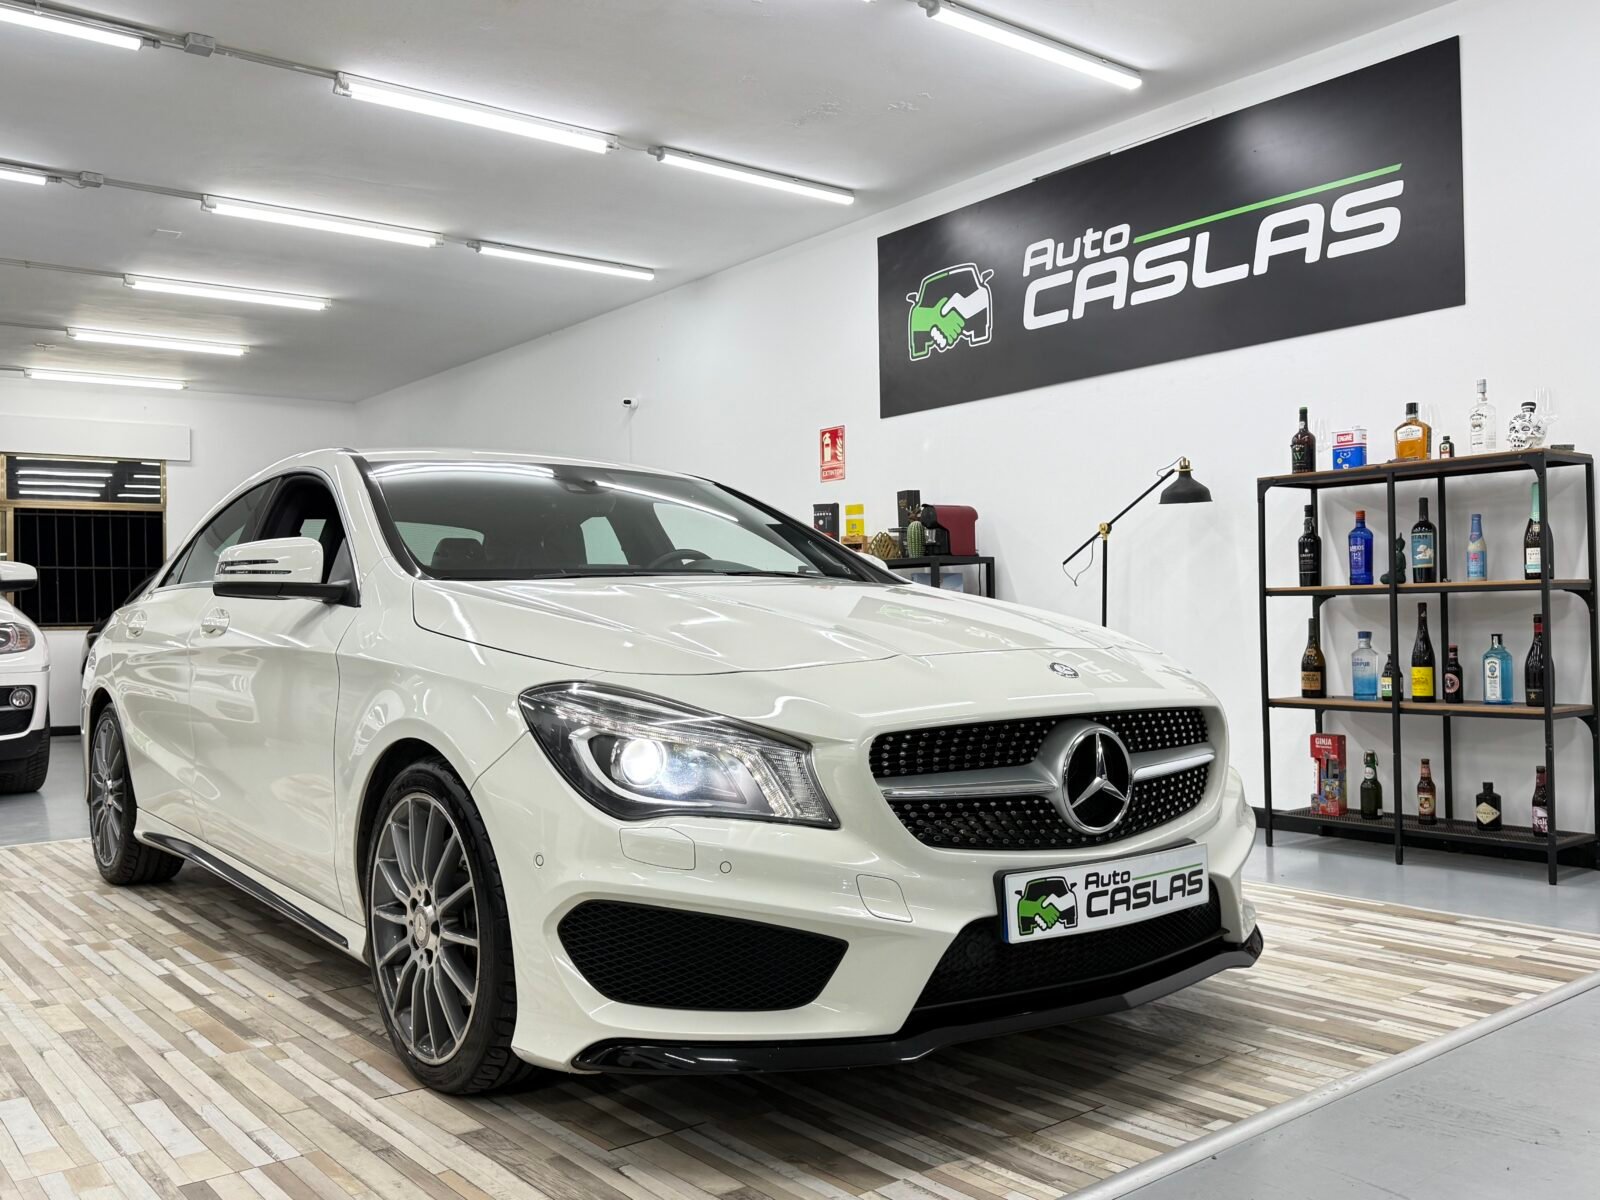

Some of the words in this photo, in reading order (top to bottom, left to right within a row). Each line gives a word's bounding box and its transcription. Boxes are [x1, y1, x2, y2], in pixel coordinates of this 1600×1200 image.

[1022, 223, 1130, 277] Auto
[1022, 180, 1404, 330] CASLAS
[1315, 737, 1332, 746] GINJA
[1085, 870, 1131, 890] Auto
[1086, 868, 1203, 918] CASLAS
